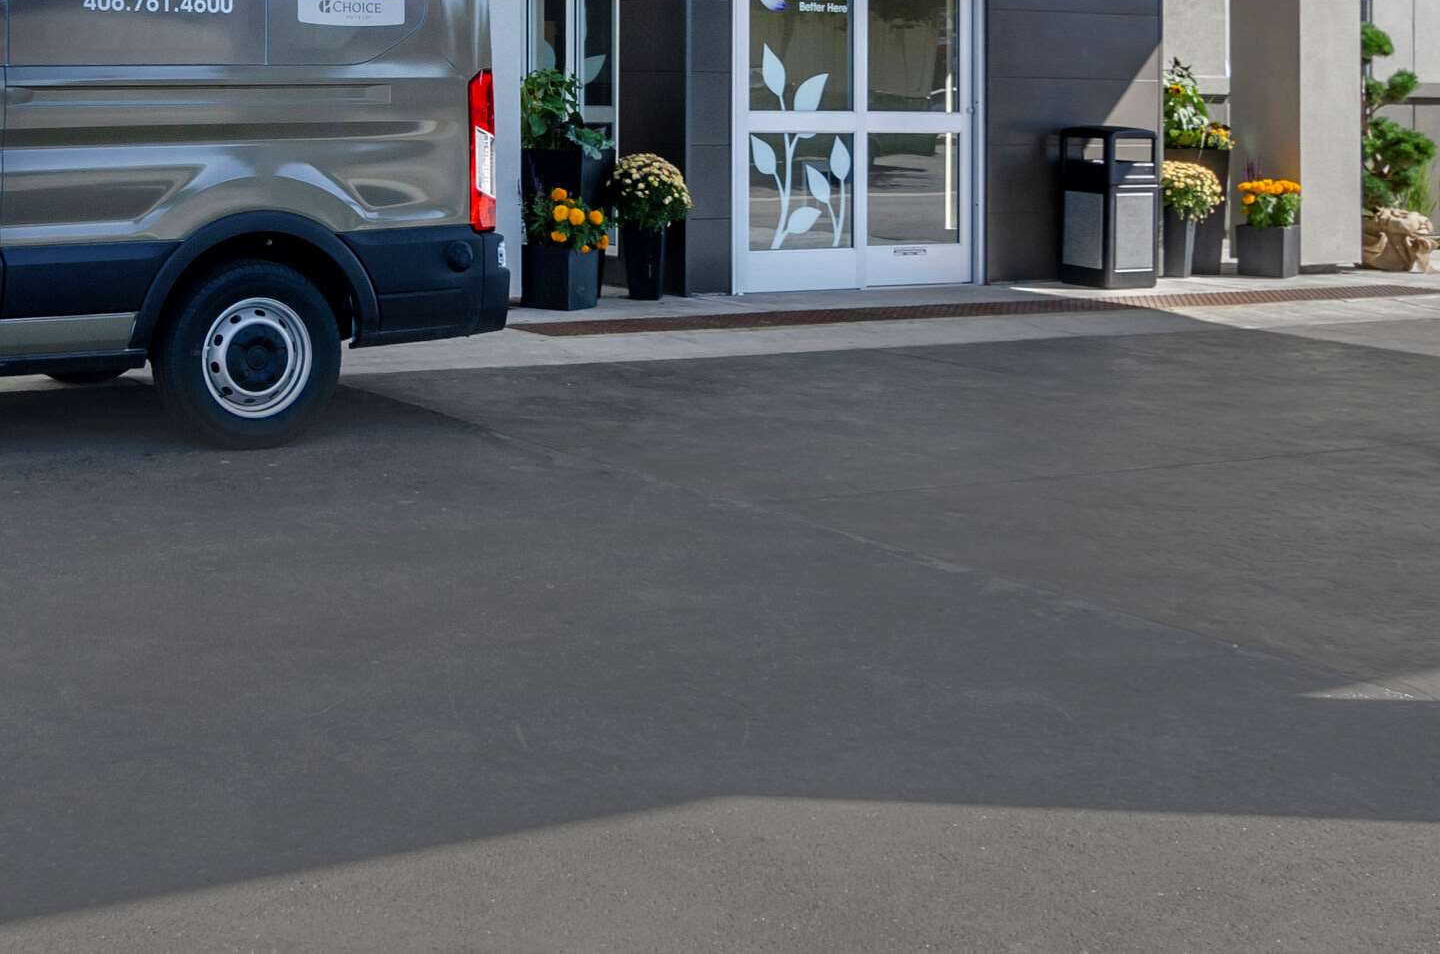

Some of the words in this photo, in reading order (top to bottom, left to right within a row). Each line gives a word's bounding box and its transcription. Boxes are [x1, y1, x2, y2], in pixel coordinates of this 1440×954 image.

[332, 0, 382, 14] CHOICE
[799, 1, 826, 12] Better
[826, 2, 849, 13] Here
